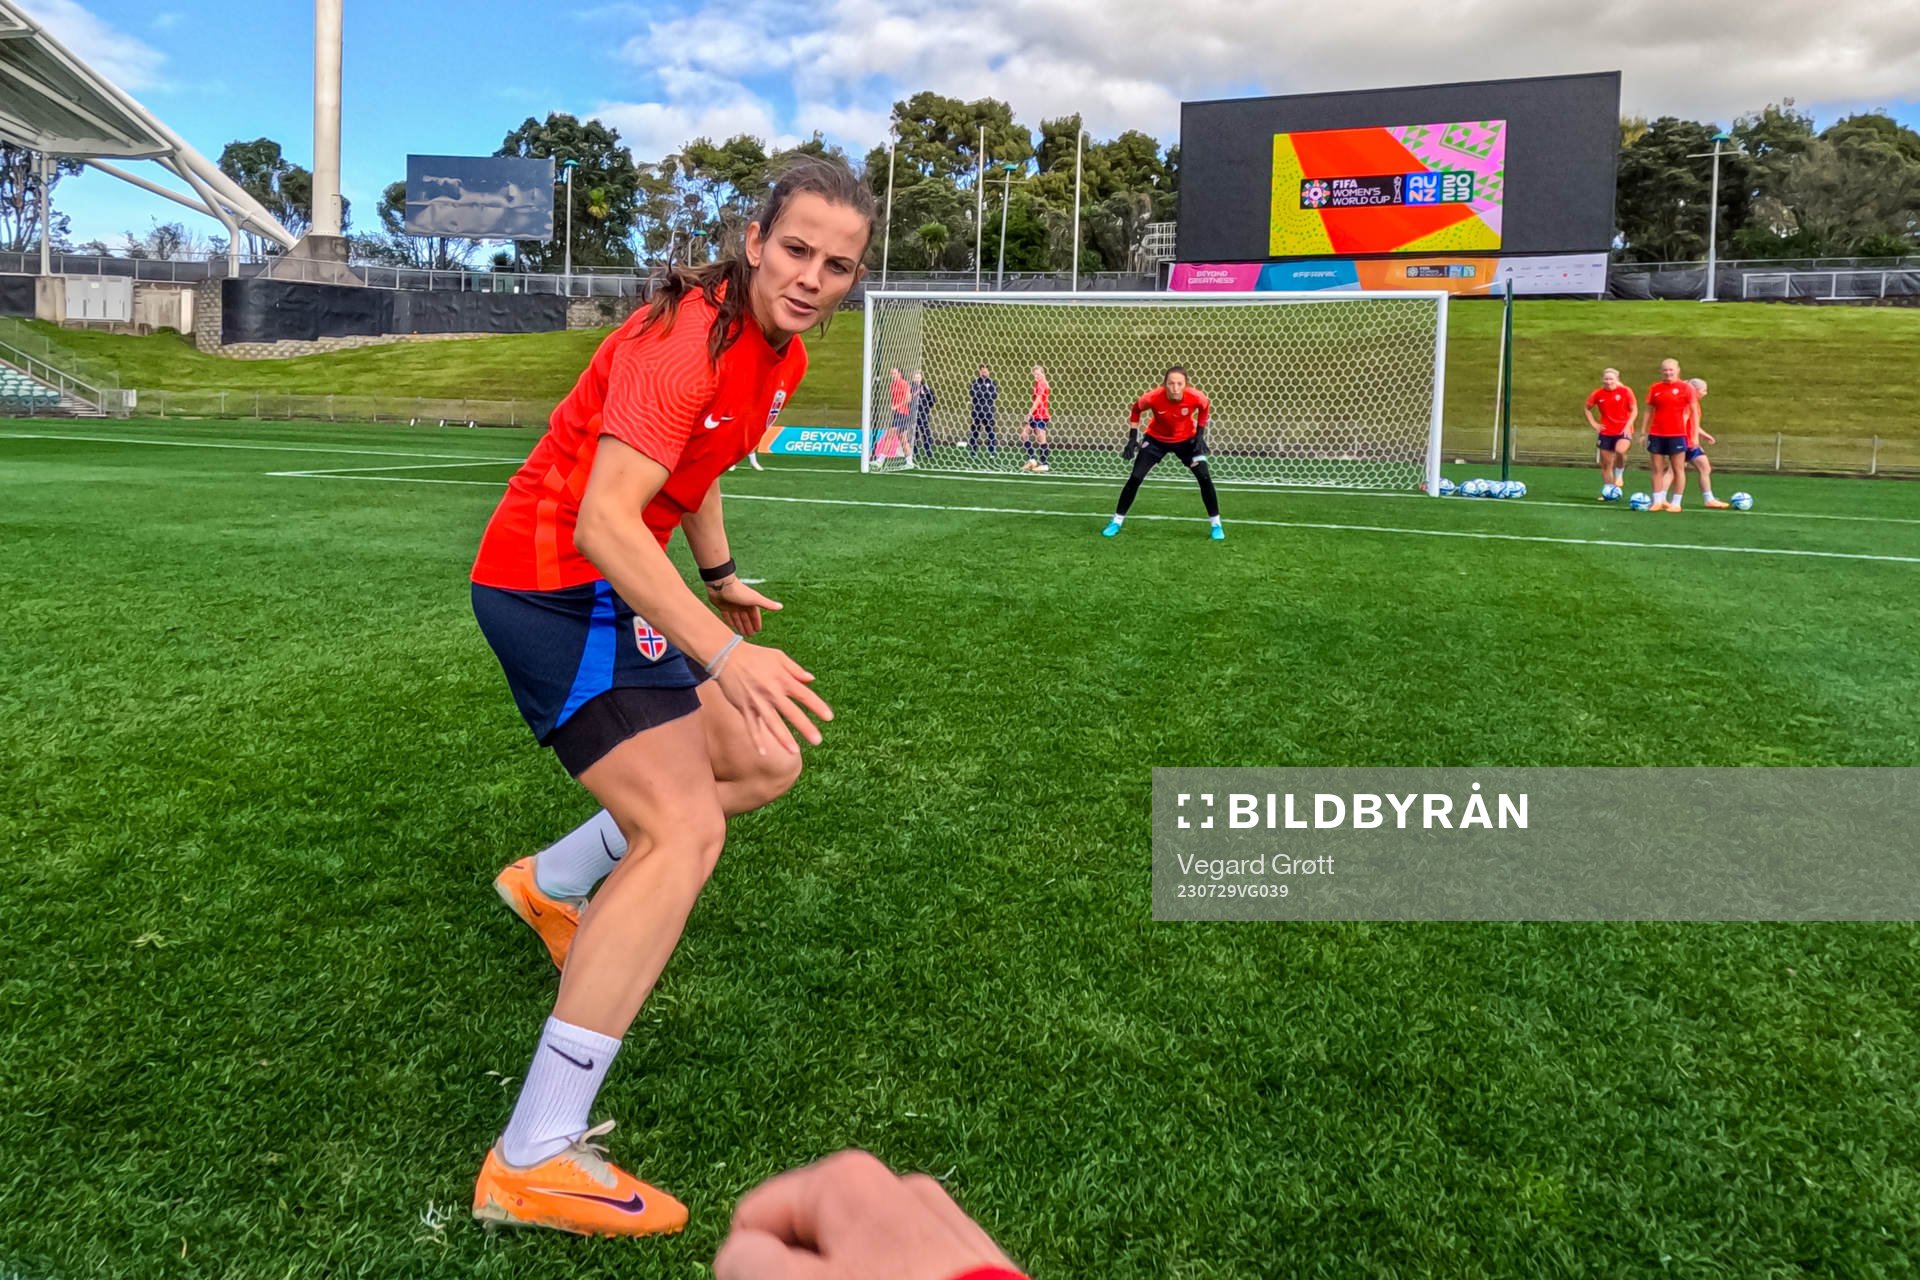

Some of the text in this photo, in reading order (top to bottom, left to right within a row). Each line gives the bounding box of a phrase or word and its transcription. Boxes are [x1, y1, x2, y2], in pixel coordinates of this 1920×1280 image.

[1332, 179, 1358, 189] FIFA
[1409, 176, 1437, 189] AU
[1443, 174, 1471, 187] 20
[1332, 187, 1381, 197] WOMEN'S
[1409, 189, 1436, 202] NZ
[1442, 187, 1471, 201] 23
[1332, 195, 1391, 206] WORLD CUP
[800, 431, 857, 442] BEYOND
